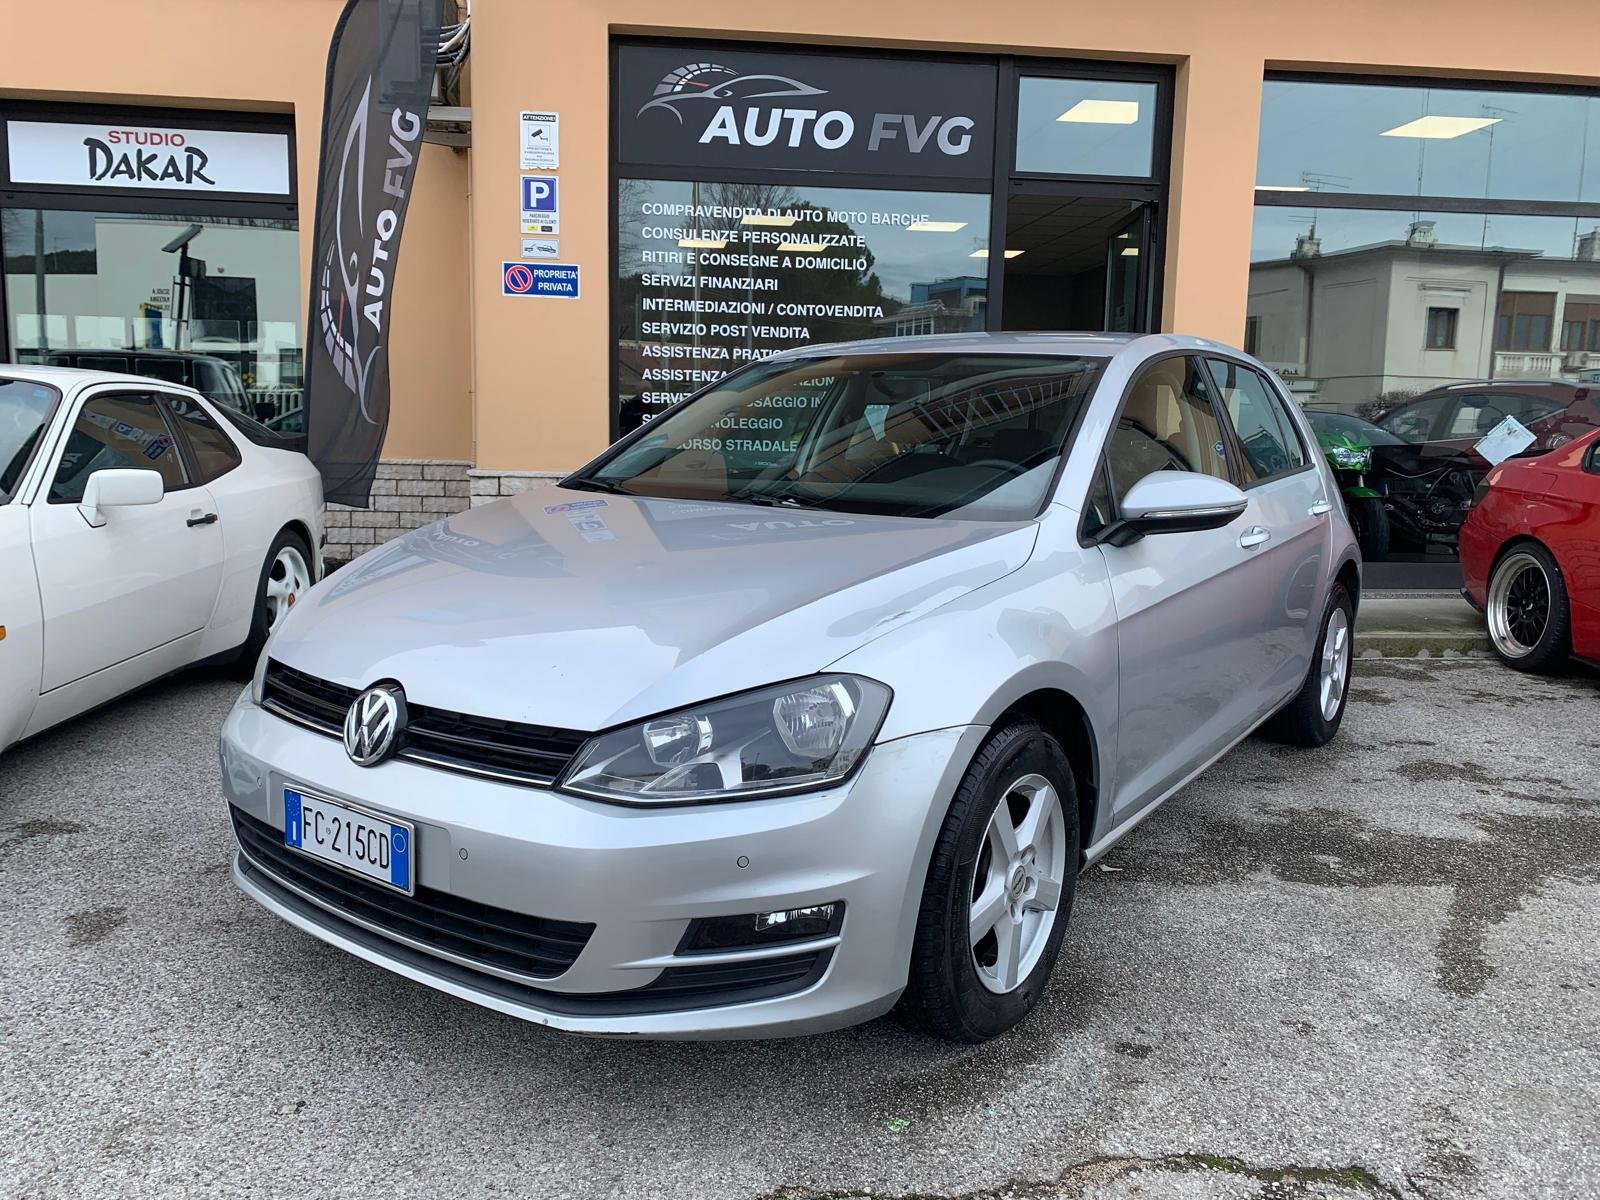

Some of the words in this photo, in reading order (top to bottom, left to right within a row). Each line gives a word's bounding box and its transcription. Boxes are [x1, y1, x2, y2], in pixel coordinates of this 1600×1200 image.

[108, 130, 185, 147] STUDIO
[698, 106, 855, 150] AUTO
[867, 113, 975, 156] FVG
[83, 137, 216, 185] DAKAR
[530, 181, 550, 208] P
[363, 209, 398, 333] AUTO
[382, 107, 421, 199] FVG
[641, 202, 764, 220] COMPRAVENDITA
[766, 208, 782, 219] DI
[784, 208, 824, 223] AUTO
[826, 211, 868, 225] MOTO
[871, 212, 929, 226] BARCHE
[641, 226, 739, 243] CONSULENZE
[742, 231, 866, 248] PERSONALIZZATE
[641, 251, 683, 264] RITIRI
[686, 253, 696, 265] E
[699, 252, 779, 268] CONSEGNE
[782, 256, 792, 268] A
[795, 256, 867, 271] DOMICILIO
[538, 282, 573, 292] PRIVATA
[641, 274, 696, 288] SERVIZI
[699, 276, 778, 291] FINANZIARI
[642, 298, 765, 315] INTERMEDIAZIONI
[776, 303, 884, 318] CONTOVENDITA
[641, 322, 706, 336] SERVIZIO
[710, 325, 748, 338] POST
[751, 325, 810, 339] VENDITA
[641, 345, 730, 360] ASSISTENZA
[725, 439, 798, 452] STRADALE
